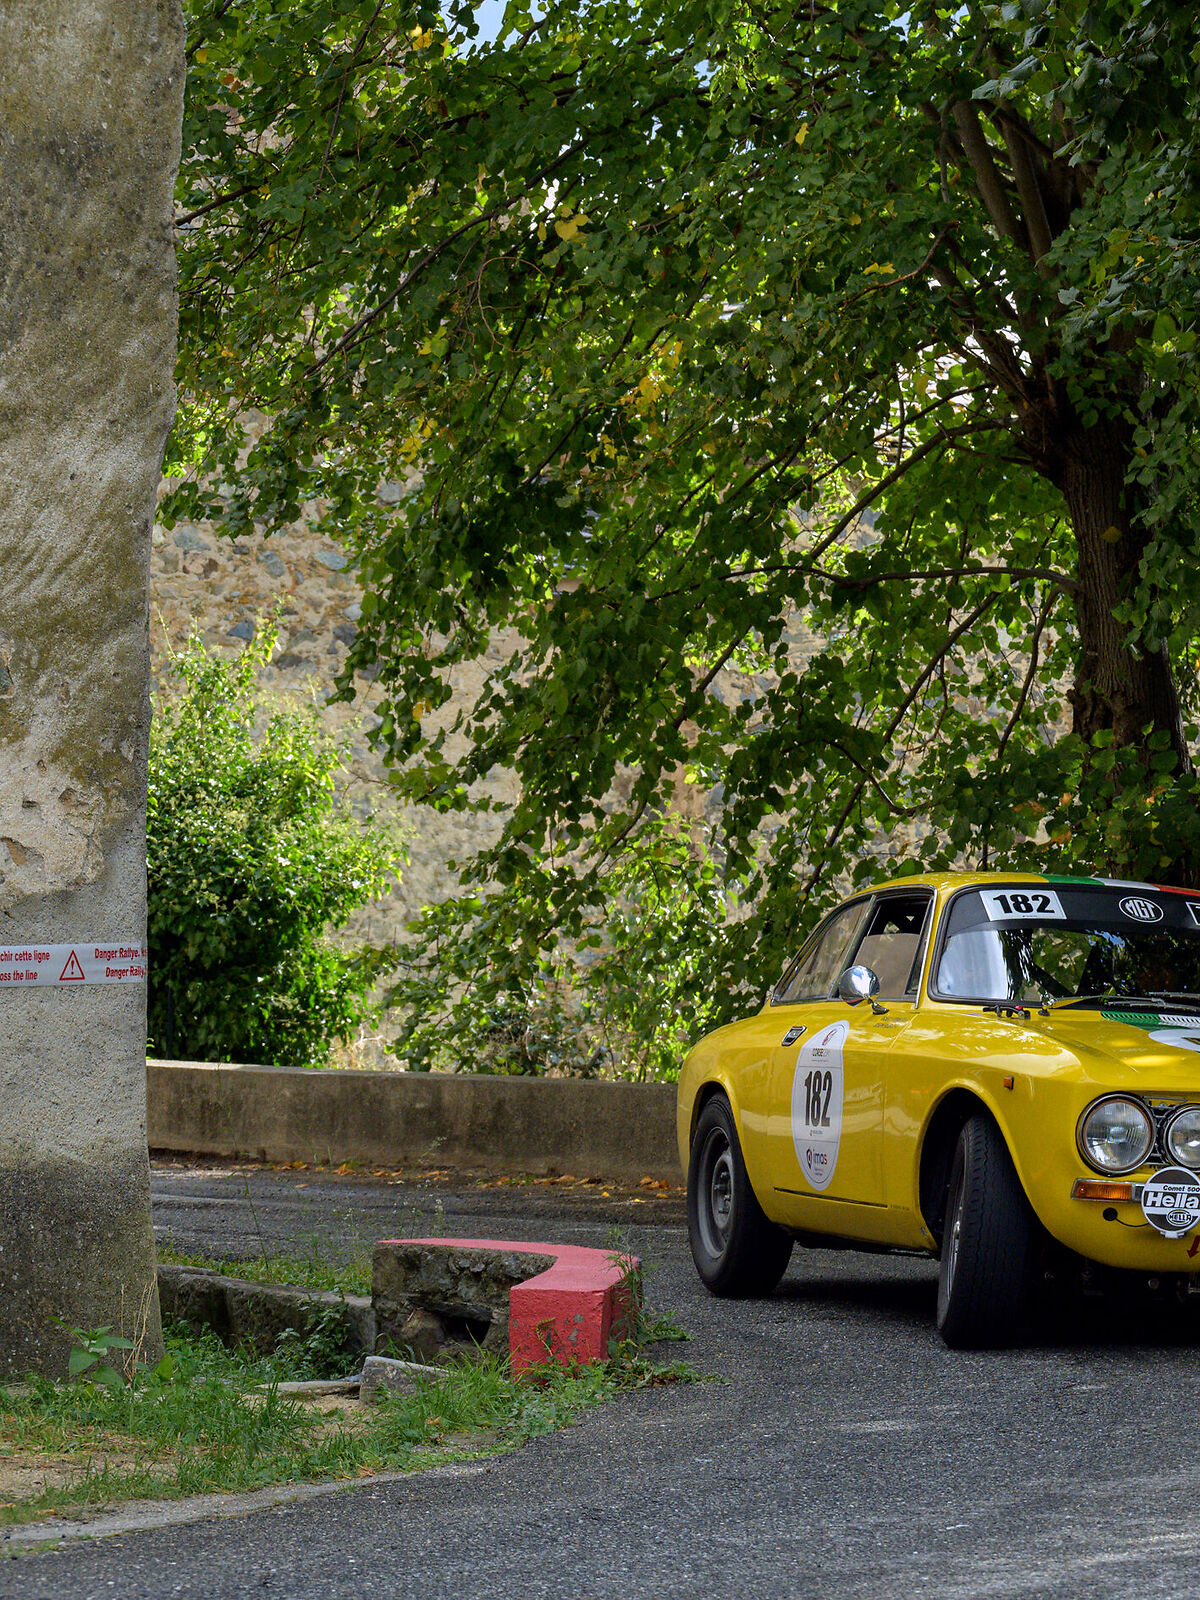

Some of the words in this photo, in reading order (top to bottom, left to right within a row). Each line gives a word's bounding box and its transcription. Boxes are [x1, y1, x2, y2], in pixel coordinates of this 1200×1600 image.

[993, 894, 1055, 914] 182
[15, 951, 32, 961] cette
[34, 950, 50, 963] ligne
[95, 948, 118, 961] Danger
[13, 970, 24, 980] the
[25, 969, 38, 980] line
[106, 966, 129, 979] Danger
[804, 1070, 832, 1127] 182
[1146, 1191, 1200, 1209] Hella
[1169, 1213, 1192, 1221] HELLA
